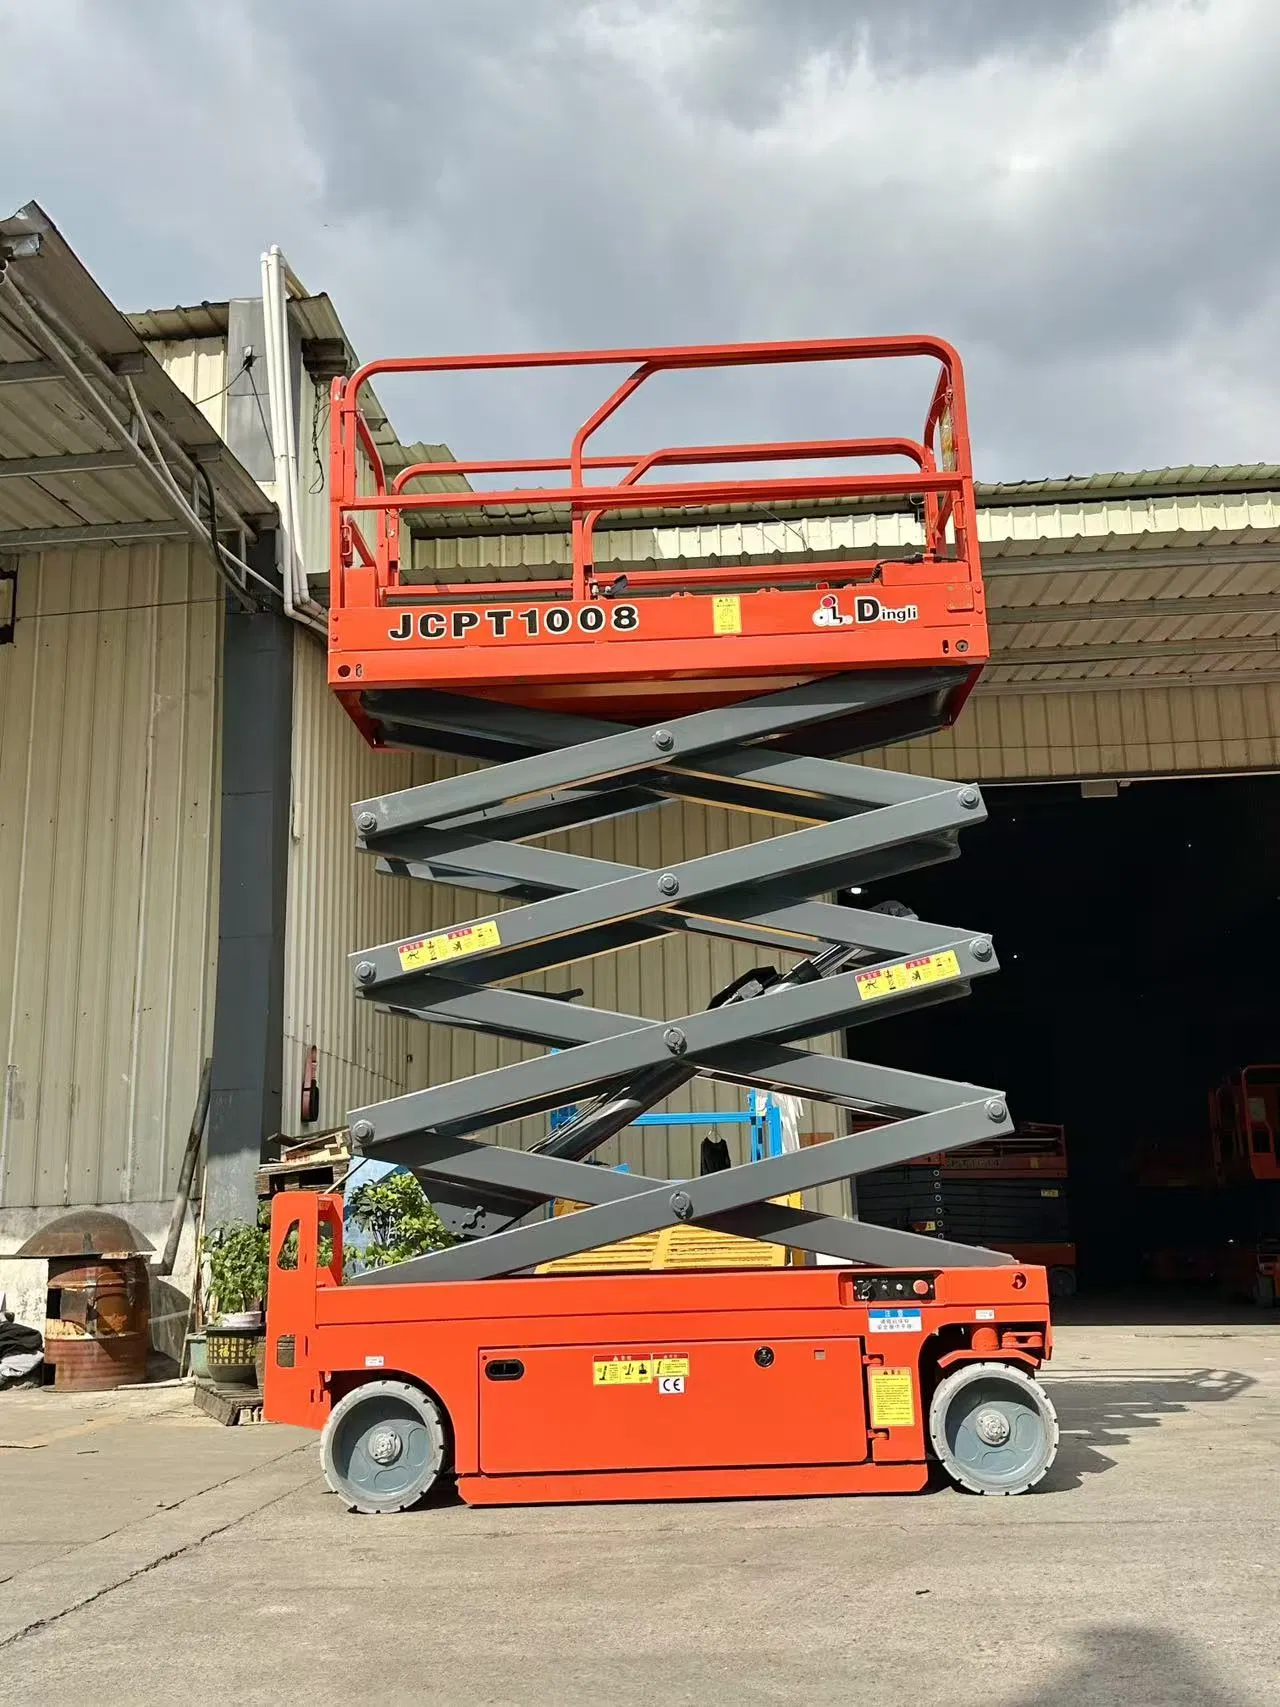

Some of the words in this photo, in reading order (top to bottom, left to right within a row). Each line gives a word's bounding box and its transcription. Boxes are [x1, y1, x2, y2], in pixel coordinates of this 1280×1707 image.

[388, 606, 639, 640] JCPT1008
[857, 598, 917, 624] Dingli
[663, 1378, 681, 1392] CE
